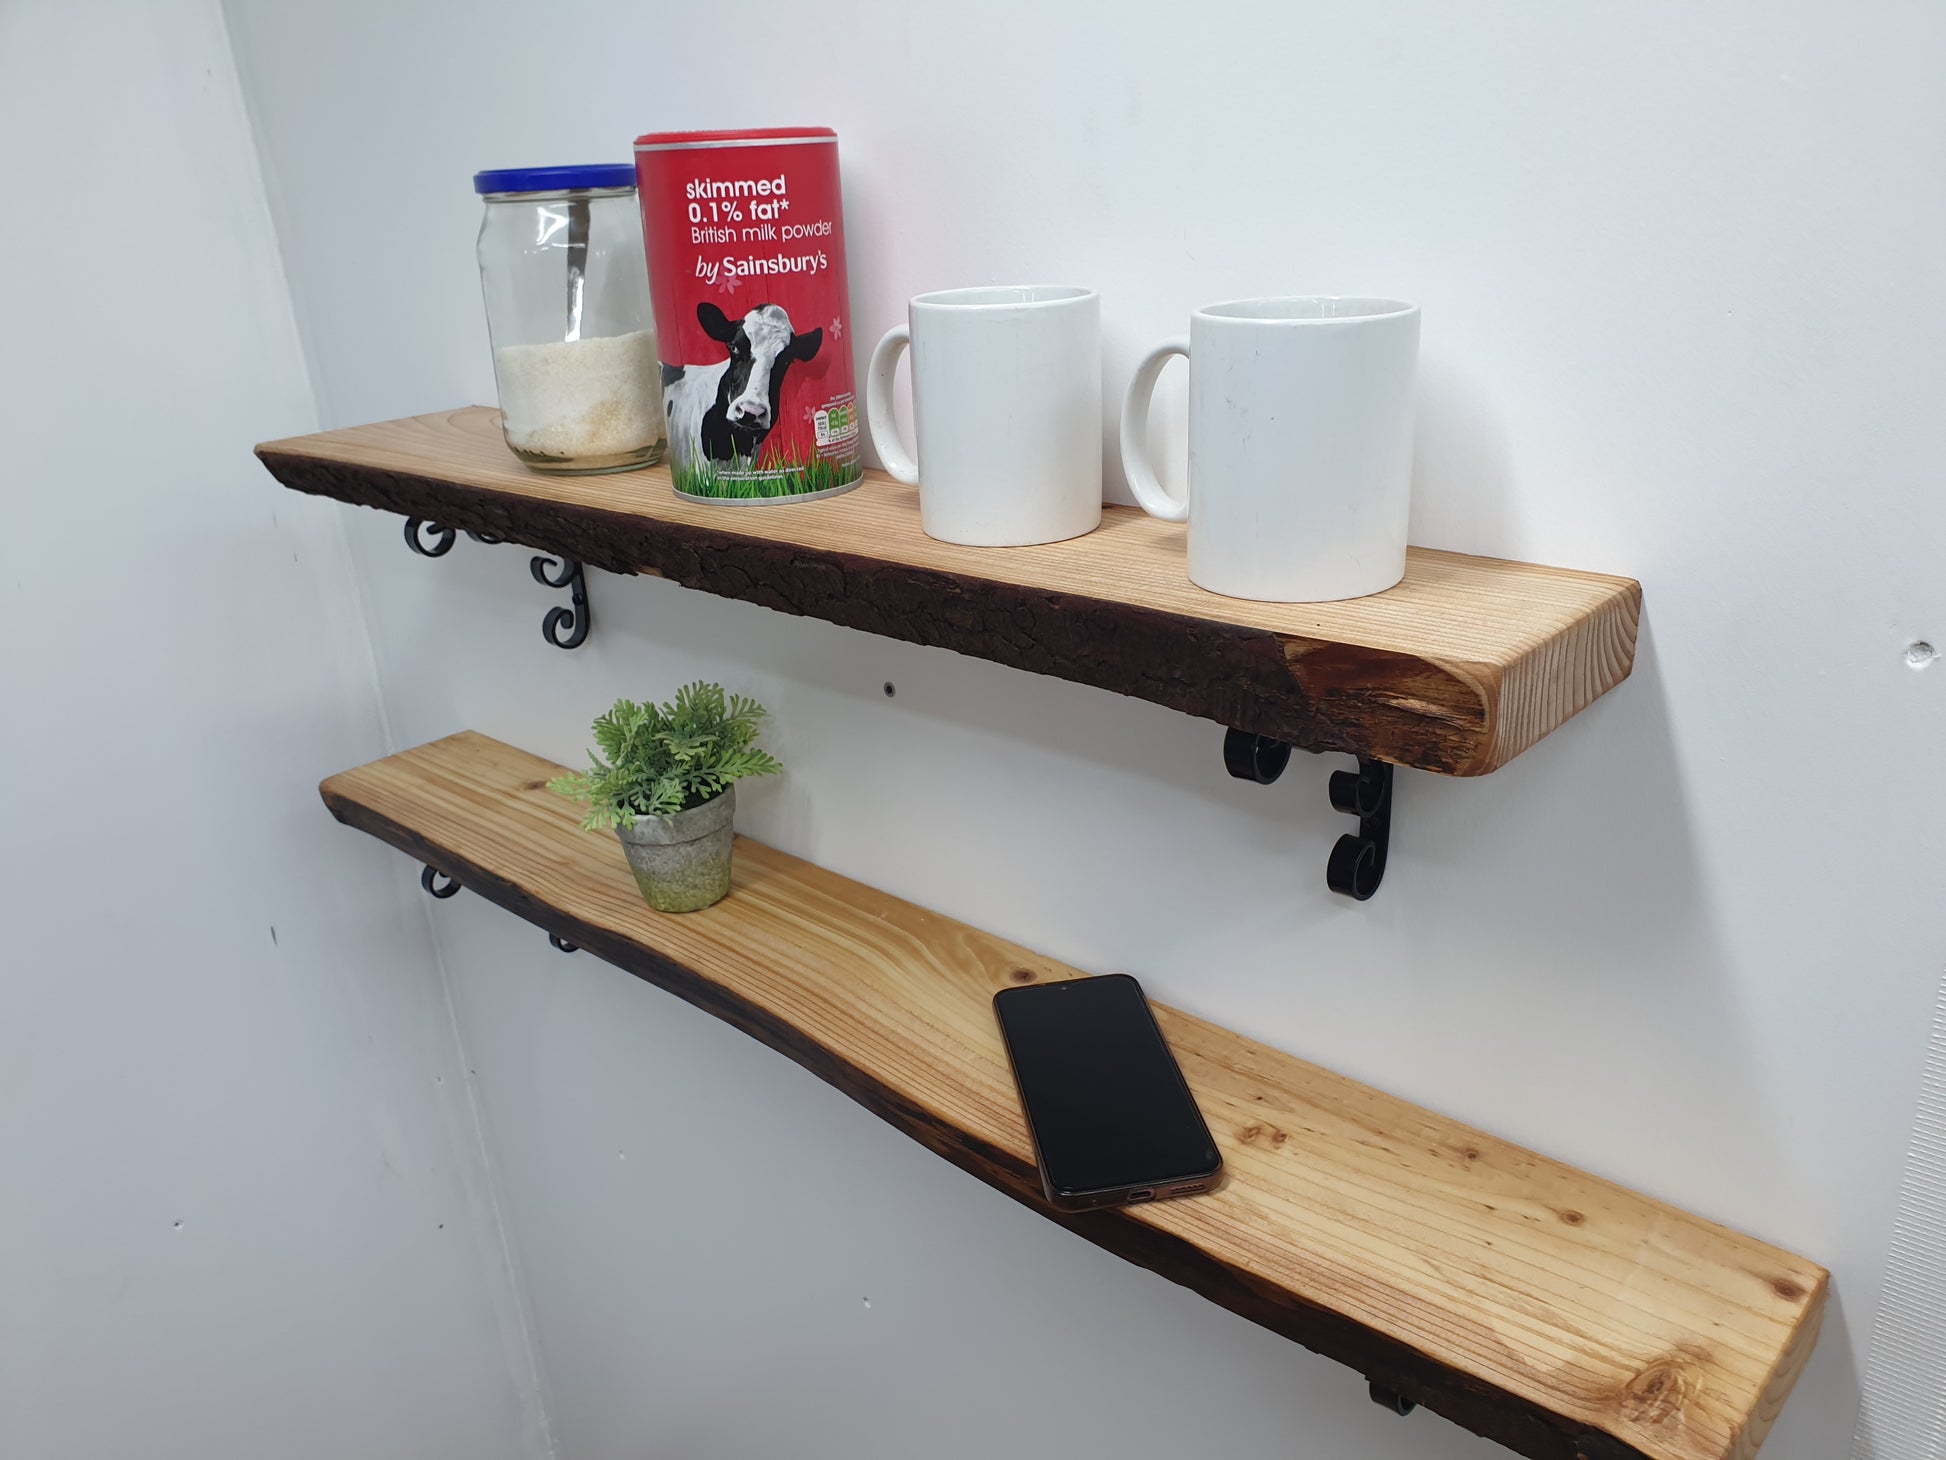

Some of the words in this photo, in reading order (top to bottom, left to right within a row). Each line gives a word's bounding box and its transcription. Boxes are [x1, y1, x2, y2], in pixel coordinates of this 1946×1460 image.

[686, 174, 786, 199] skimmed
[688, 200, 743, 224] 0.1%
[691, 224, 737, 244] British
[742, 223, 777, 242] milk
[782, 220, 832, 243] powder
[695, 255, 720, 285] by
[723, 250, 828, 277] Sainsbury's
